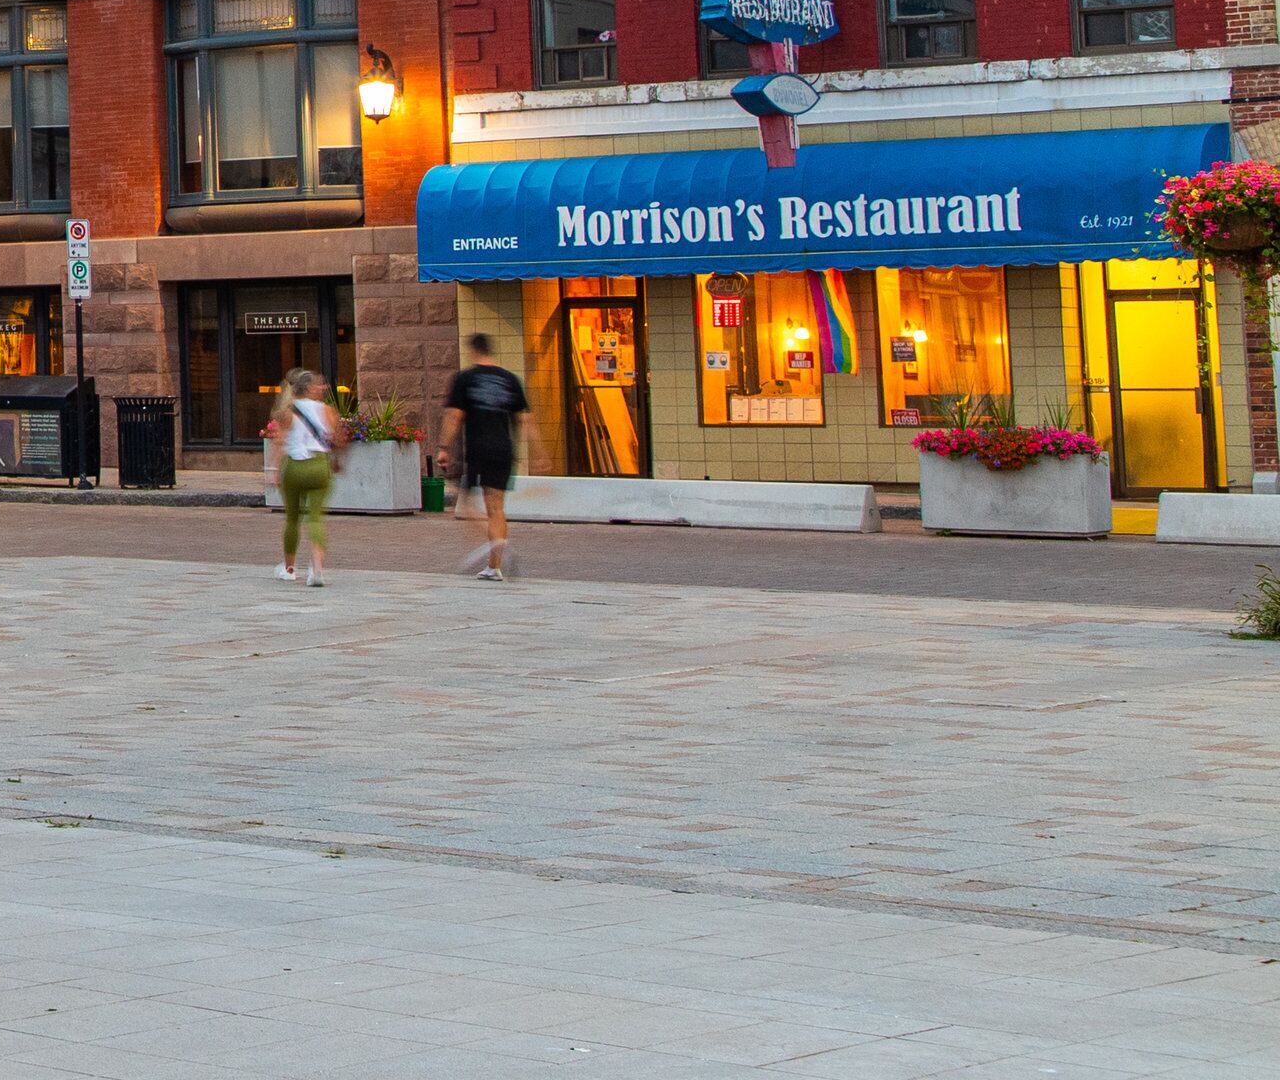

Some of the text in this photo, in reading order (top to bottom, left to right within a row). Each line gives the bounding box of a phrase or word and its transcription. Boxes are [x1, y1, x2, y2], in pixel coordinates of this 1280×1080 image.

[556, 186, 1022, 247] Morrison's Restaurant
[1080, 216, 1133, 228] Est. 1921
[452, 236, 518, 251] ENTRANCE
[707, 278, 741, 291] OPEN
[894, 416, 918, 425] CLOSED
